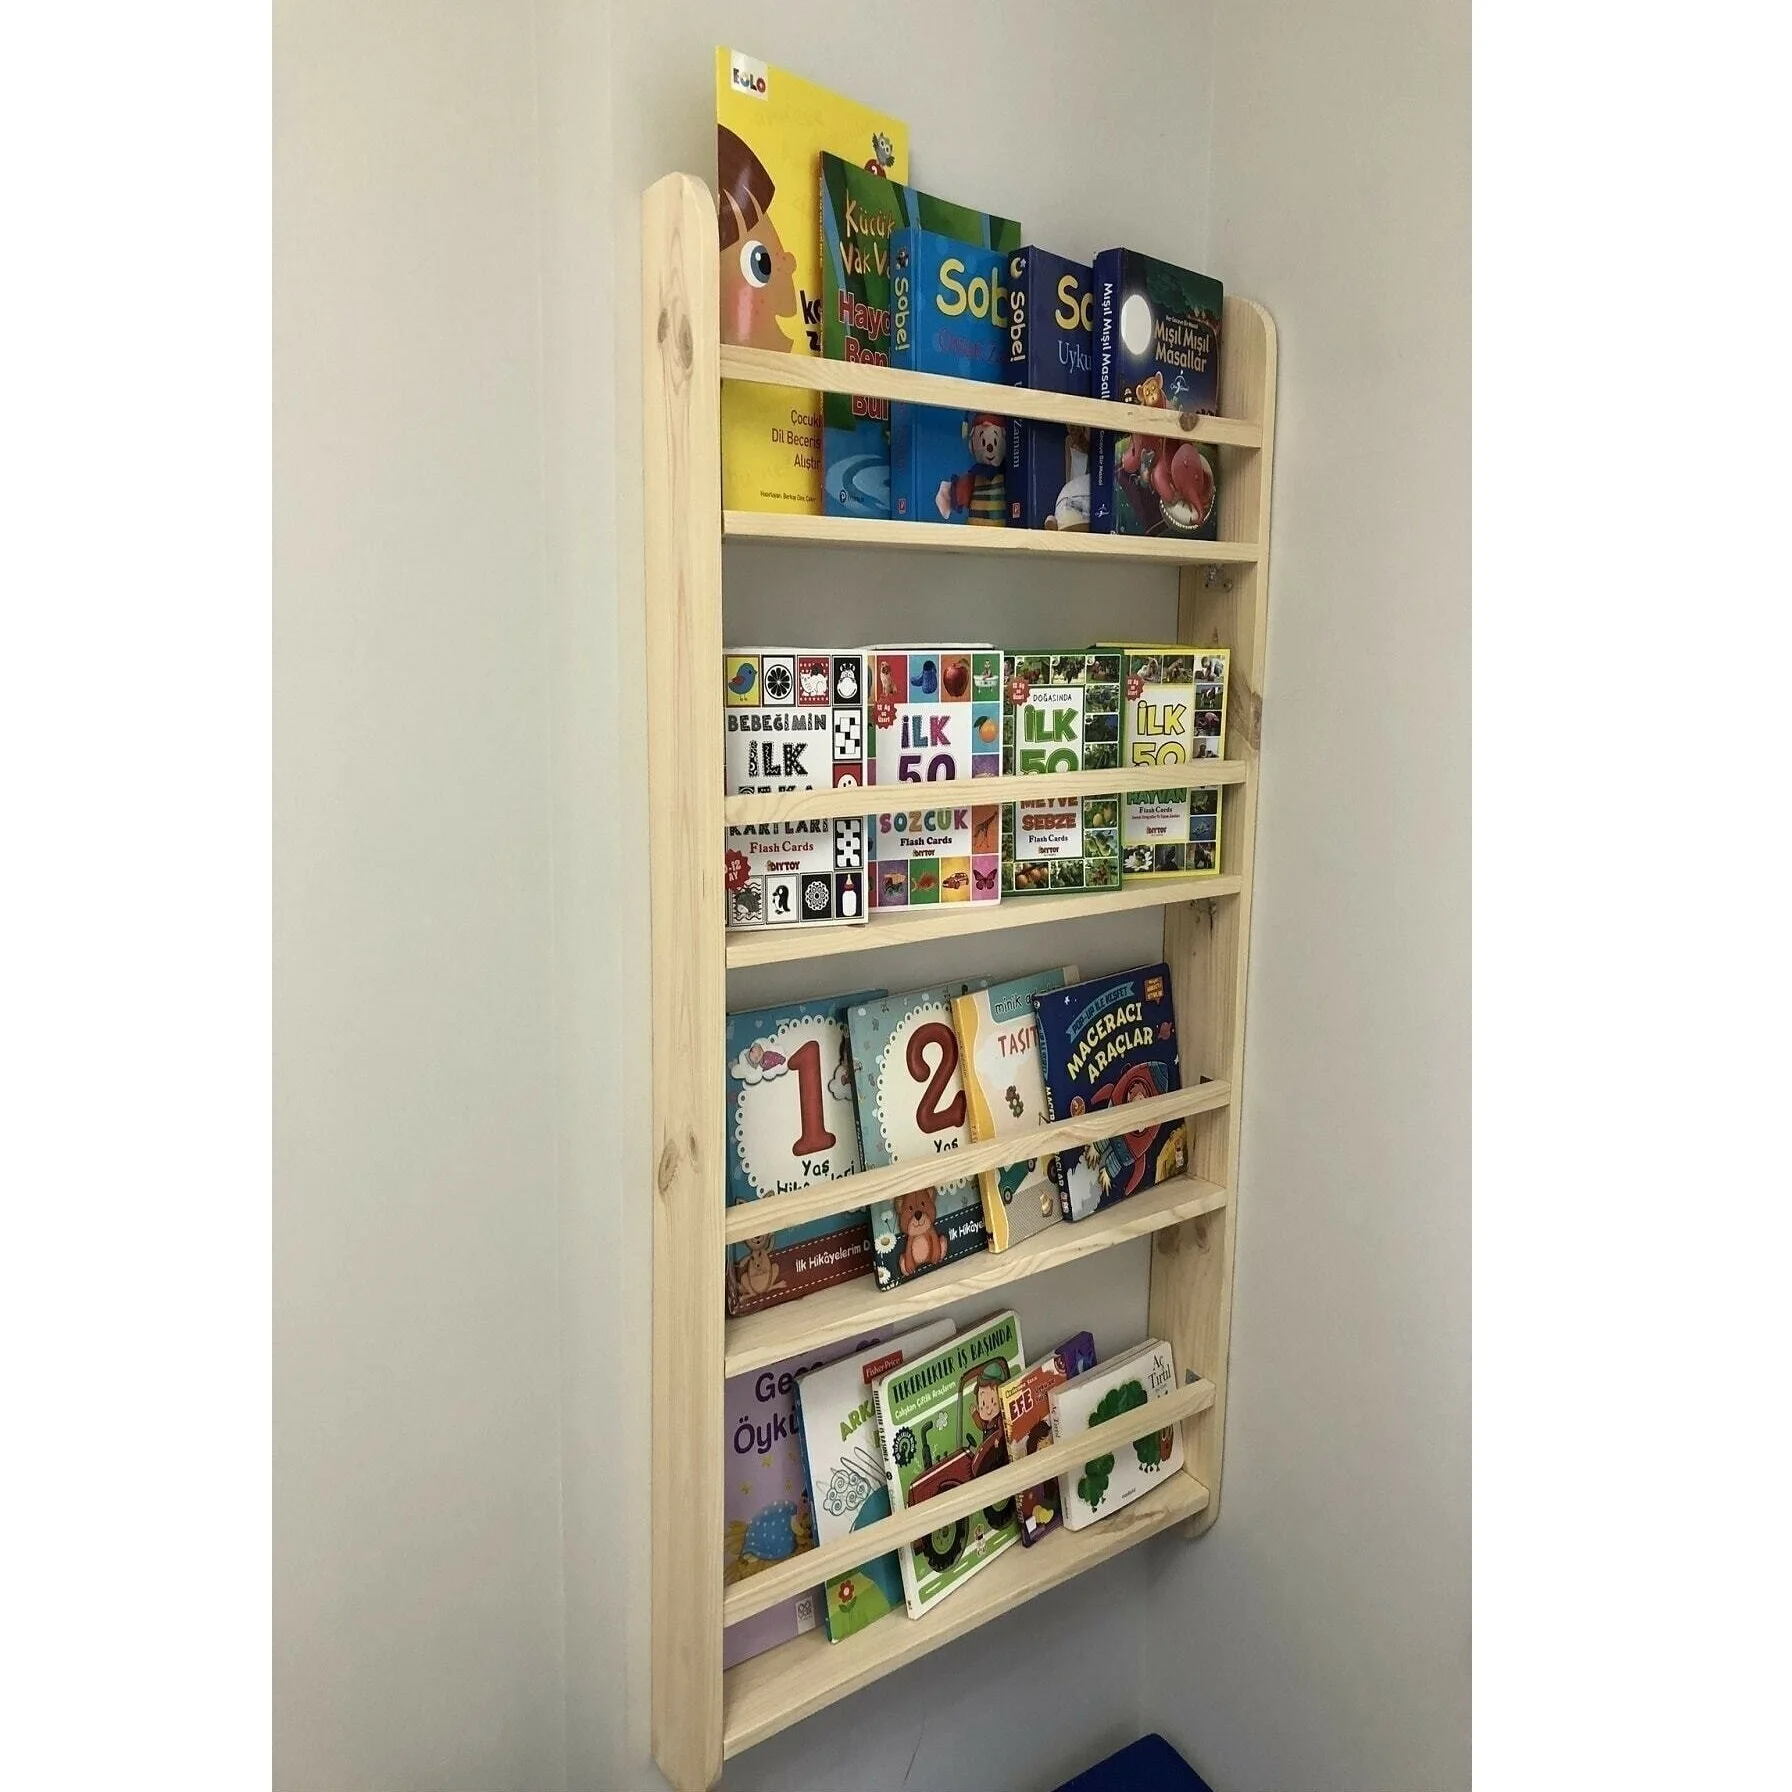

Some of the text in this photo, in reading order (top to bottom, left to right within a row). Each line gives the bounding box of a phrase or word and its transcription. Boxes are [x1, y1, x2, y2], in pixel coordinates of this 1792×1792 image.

[733, 68, 766, 93] EOLO
[840, 241, 871, 275] Vak
[1101, 282, 1114, 313] Mışıl
[894, 276, 911, 351] Sobe!
[1010, 291, 1026, 362] Sobe!
[1100, 318, 1113, 351] Mışıl
[1154, 319, 1209, 356] Mışıl Mışıl
[1057, 339, 1092, 374] Uyku
[1155, 342, 1207, 373] Masallar
[771, 428, 784, 443] Dil
[1033, 693, 1072, 702] DOĞASINDA
[727, 713, 827, 731] BEBEĞİMİN
[901, 715, 951, 749] İLK
[1024, 704, 1079, 743] İLK
[1137, 699, 1187, 736] İLK
[748, 740, 808, 777] İLK
[899, 753, 956, 782] 50
[1020, 747, 1079, 775] 50
[1132, 741, 1186, 766] 50
[1022, 812, 1077, 831] SEBZE
[749, 841, 814, 854] Flash Cards
[900, 836, 952, 847] Flash Cards
[1028, 834, 1068, 843] Flash Cards
[995, 992, 1022, 1015] minik
[1066, 1002, 1143, 1081] MACERACI
[1087, 1026, 1153, 1085] ARAÇLAR
[905, 1022, 967, 1134] 2
[787, 1040, 836, 1156] 1
[802, 1160, 829, 1176] Yaş
[795, 1259, 807, 1272] İlk
[808, 1243, 861, 1269] Hikâyelerim
[865, 1358, 900, 1378] Fisher-Price
[892, 1356, 955, 1404] TEKERLEKLER
[970, 1325, 1013, 1361] BAŞINDA
